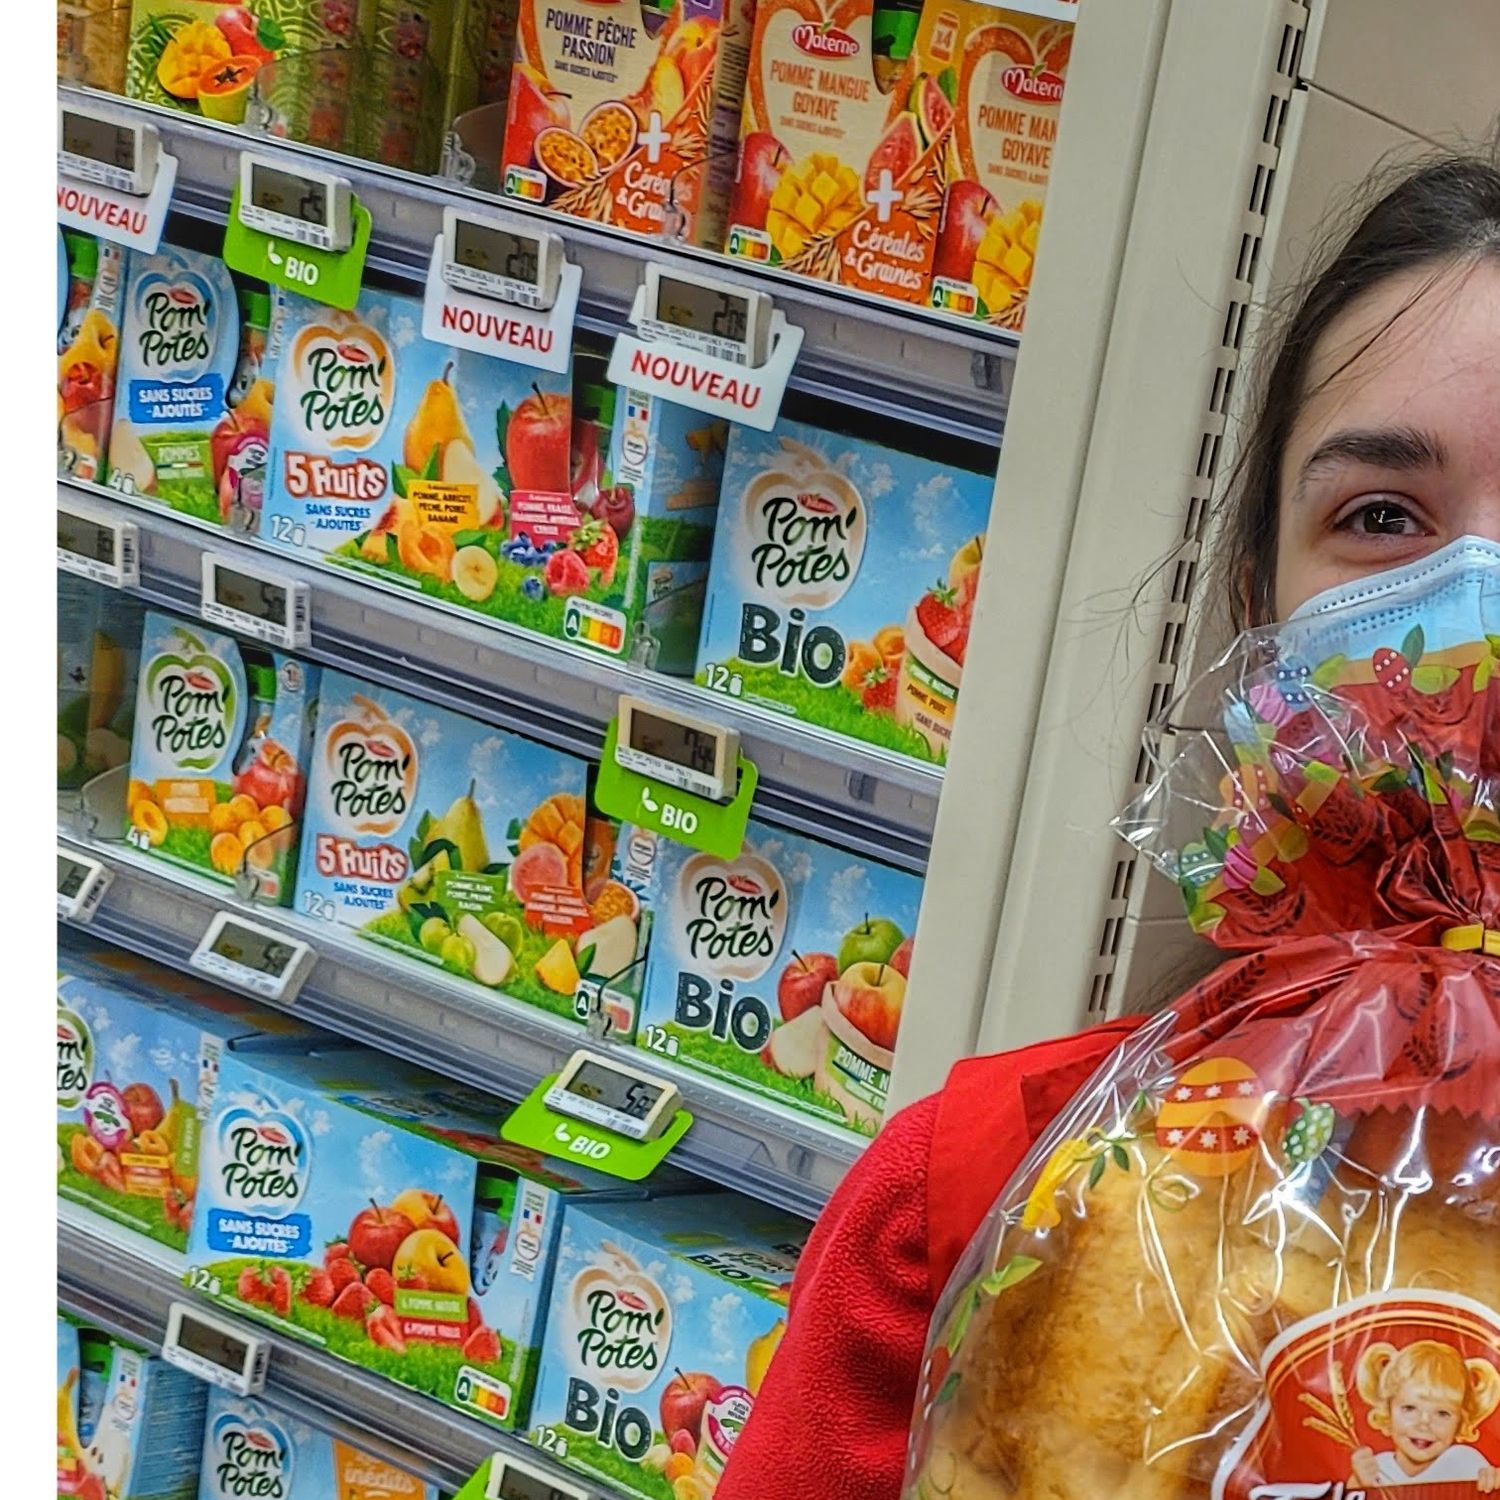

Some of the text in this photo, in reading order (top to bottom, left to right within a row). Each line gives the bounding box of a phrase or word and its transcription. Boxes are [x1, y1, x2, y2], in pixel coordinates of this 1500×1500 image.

[545, 9, 637, 49] POMME PÊCHE
[794, 25, 859, 55] Materne
[562, 35, 616, 67] PASSION
[771, 60, 870, 102] POMME MANGUE
[1005, 71, 1063, 98] Matern
[792, 92, 839, 121] GOYAVE
[978, 105, 1024, 136] POMME
[1002, 139, 1050, 168] GOYAVE
[852, 220, 924, 262] Céréales
[284, 257, 319, 285] BIO
[442, 305, 554, 353] NOUVEAU
[140, 329, 209, 366] Potes
[139, 387, 213, 403] SANS SUCRES
[631, 350, 761, 409] NOUVEAU
[300, 390, 384, 432] Potes
[286, 453, 387, 500] 5 Fruits
[306, 503, 371, 519] SANS SUCRES
[752, 543, 850, 588] Potes
[739, 604, 846, 685] Bio
[153, 715, 225, 755] Potes
[332, 781, 406, 816] Potes
[661, 802, 697, 834] BIO
[317, 836, 407, 880] 5 Fruits
[334, 882, 394, 899] SANS SUCRES
[686, 917, 773, 959] Potes
[675, 972, 772, 1051] Bio
[646, 1026, 665, 1051] 12
[835, 1046, 877, 1084] POMME
[569, 1136, 610, 1160] BIO
[223, 1163, 298, 1198] Potes
[219, 1217, 300, 1239] SANS SUCRES
[190, 1266, 210, 1290] 12
[578, 1329, 657, 1371] Potes
[565, 1377, 651, 1459] Bio
[536, 1425, 555, 1451] 12
[217, 1464, 283, 1498] Potes
